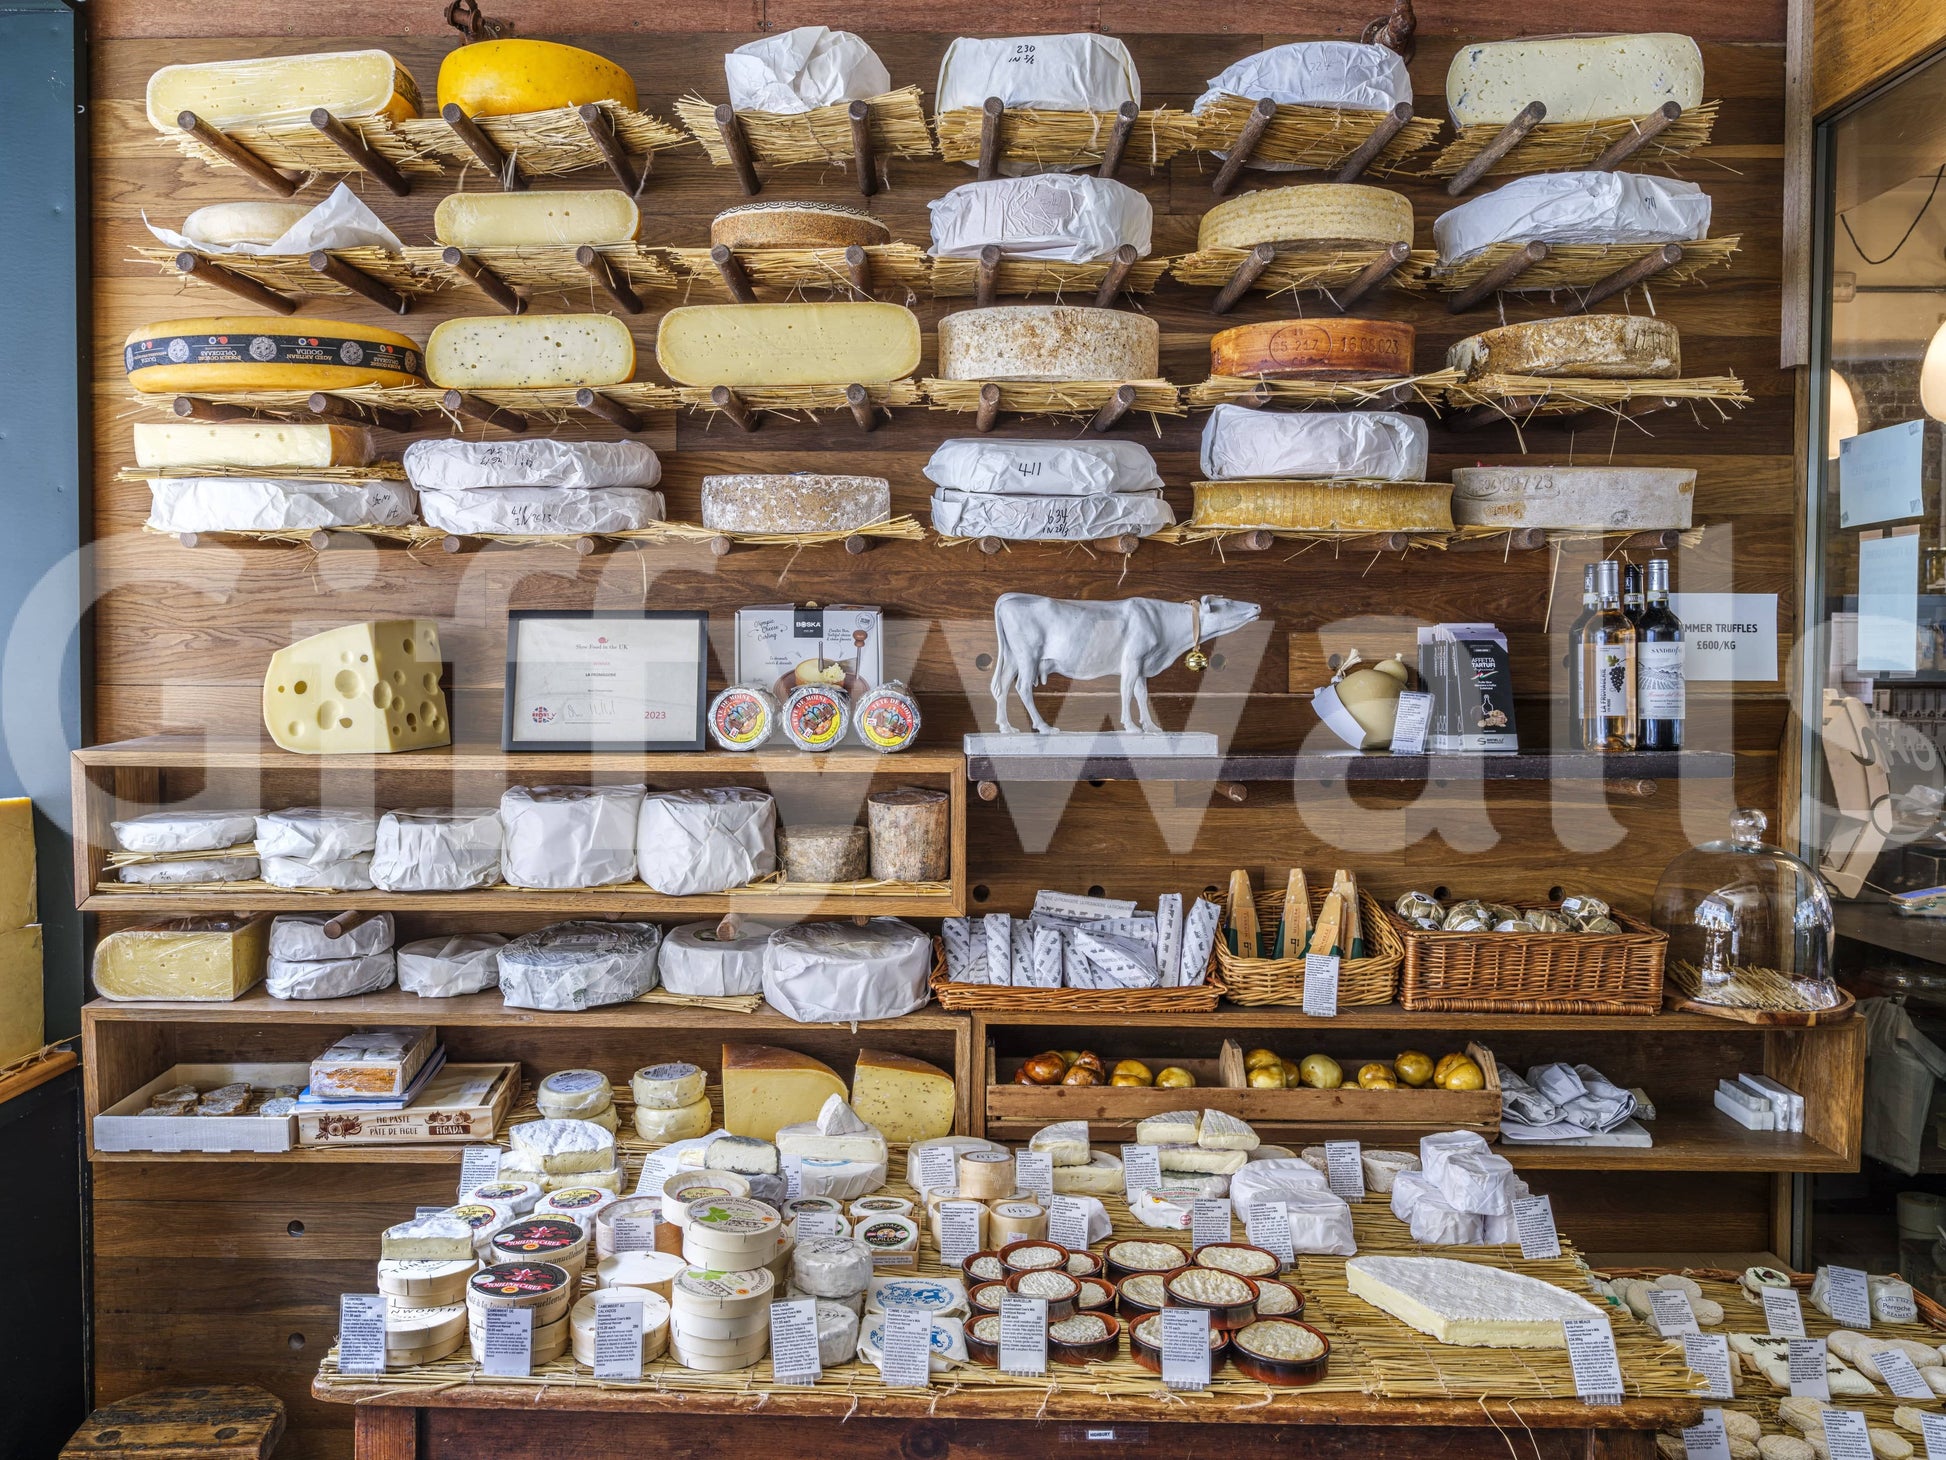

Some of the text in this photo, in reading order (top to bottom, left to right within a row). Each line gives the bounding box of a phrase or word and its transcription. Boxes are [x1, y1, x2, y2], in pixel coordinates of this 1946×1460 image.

[1016, 44, 1035, 54] 230
[1018, 462, 1042, 477] 411
[1048, 508, 1068, 524] 634
[1715, 624, 1758, 633] TRUFFLES
[1696, 641, 1736, 651] £600/KG
[1601, 705, 1607, 713] LA
[644, 711, 666, 720] 2023
[436, 1126, 464, 1134] FIGADA
[1882, 1303, 1911, 1312] Perroche
